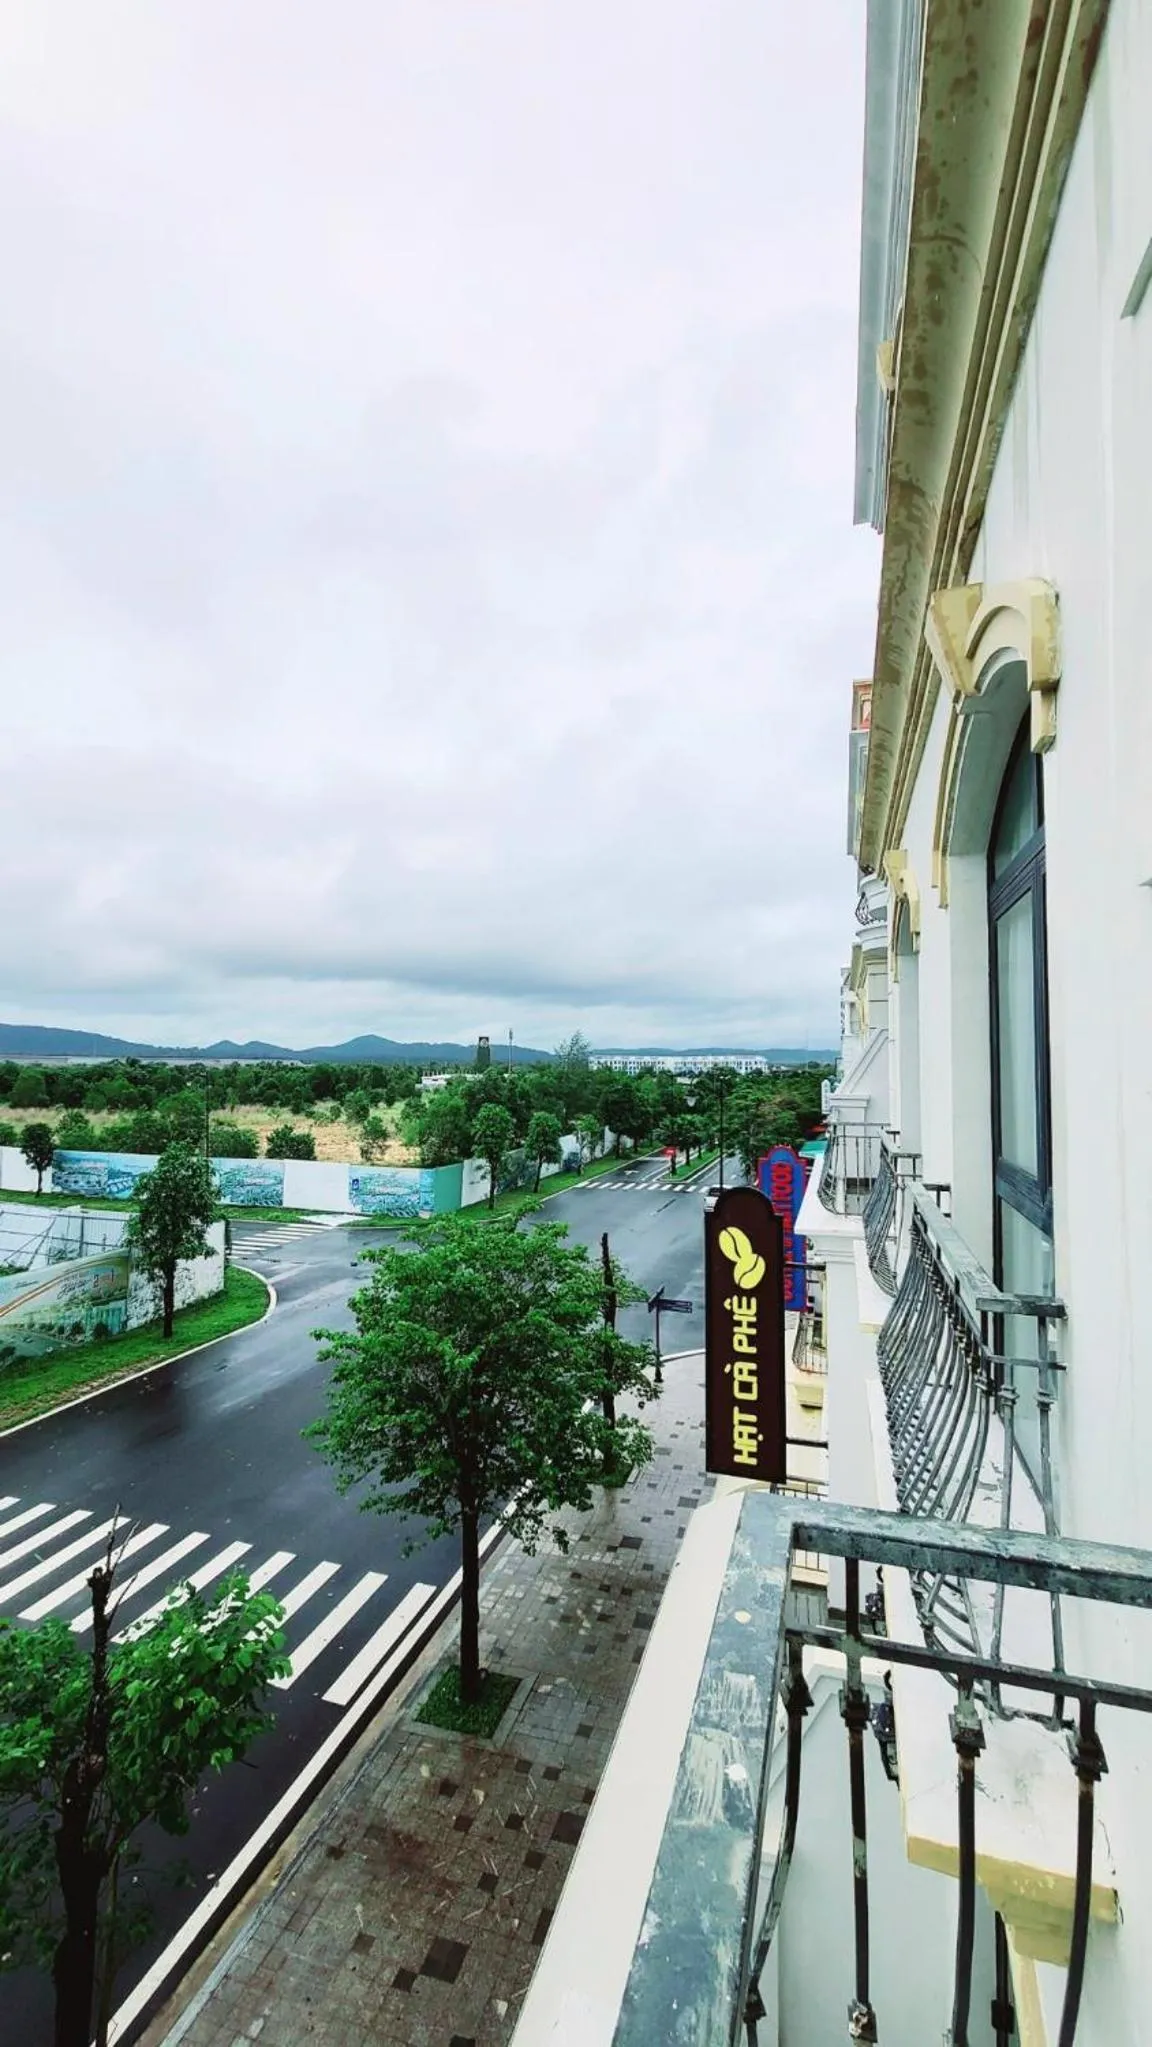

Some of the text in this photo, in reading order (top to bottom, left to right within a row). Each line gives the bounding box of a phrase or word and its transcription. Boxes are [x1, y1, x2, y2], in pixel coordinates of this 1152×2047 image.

[723, 1295, 764, 1466] HẠT CÀ PHÊ
